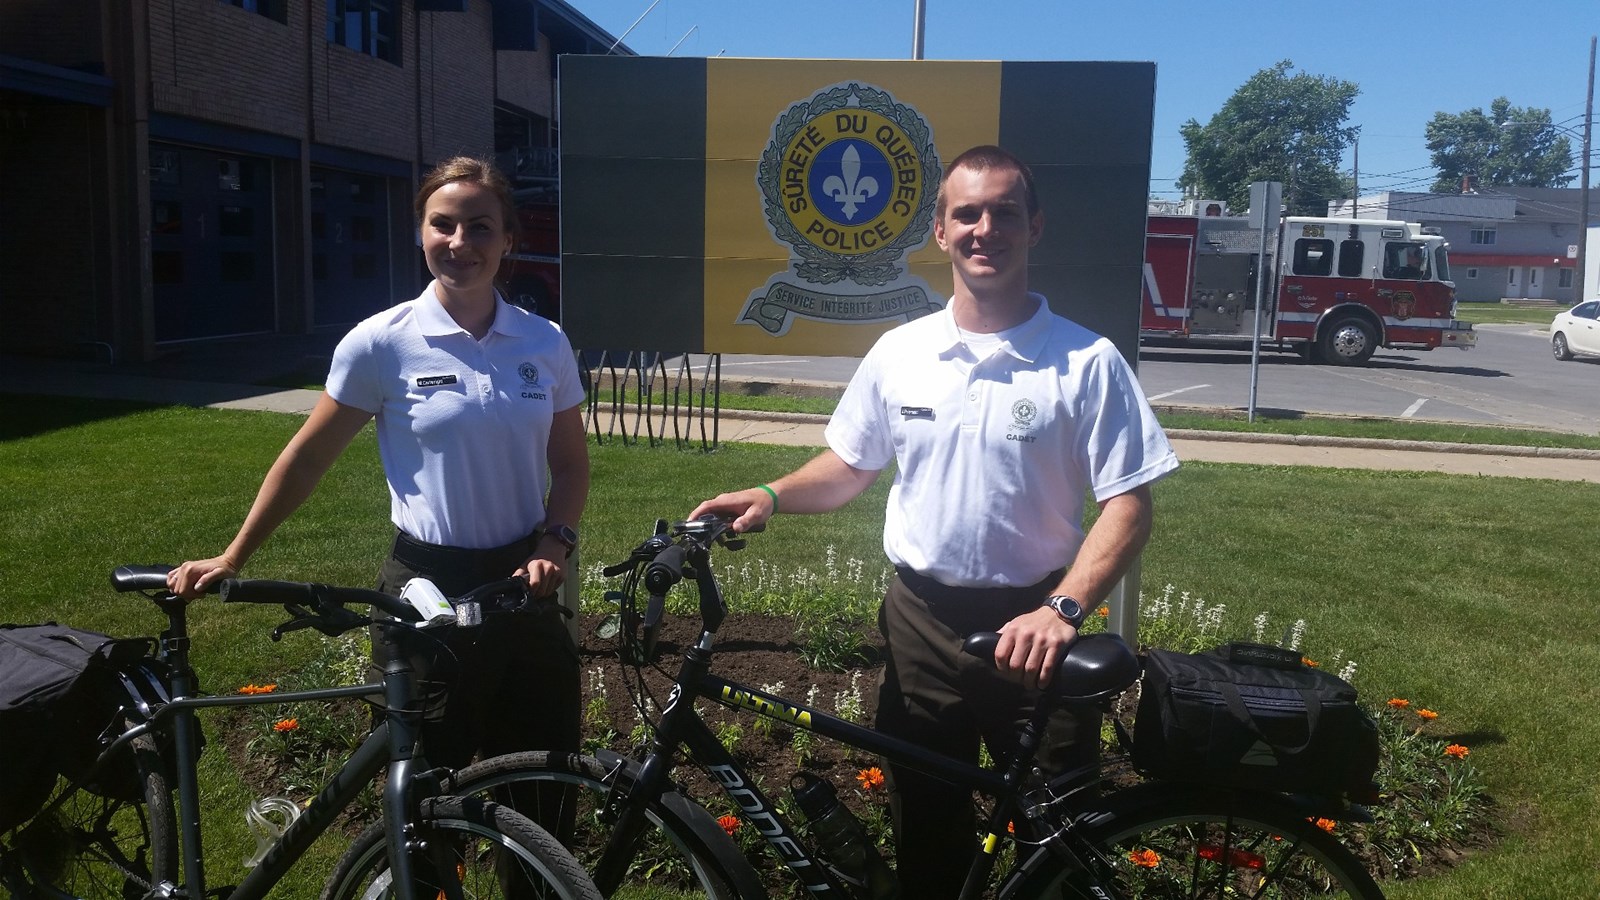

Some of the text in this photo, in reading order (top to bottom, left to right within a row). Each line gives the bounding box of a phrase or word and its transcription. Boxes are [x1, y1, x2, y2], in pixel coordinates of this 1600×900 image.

[782, 114, 917, 217] SÛRETÉ DU QUÉBEC
[197, 212, 206, 239] 1
[335, 221, 345, 244] 2
[806, 219, 894, 250] POLICE
[1302, 224, 1325, 238] 251
[775, 289, 814, 310] SERVICE
[878, 291, 921, 312] JUSTICE
[521, 391, 547, 401] CADET
[1006, 433, 1037, 443] CADET
[721, 685, 812, 729] ULTIMA
